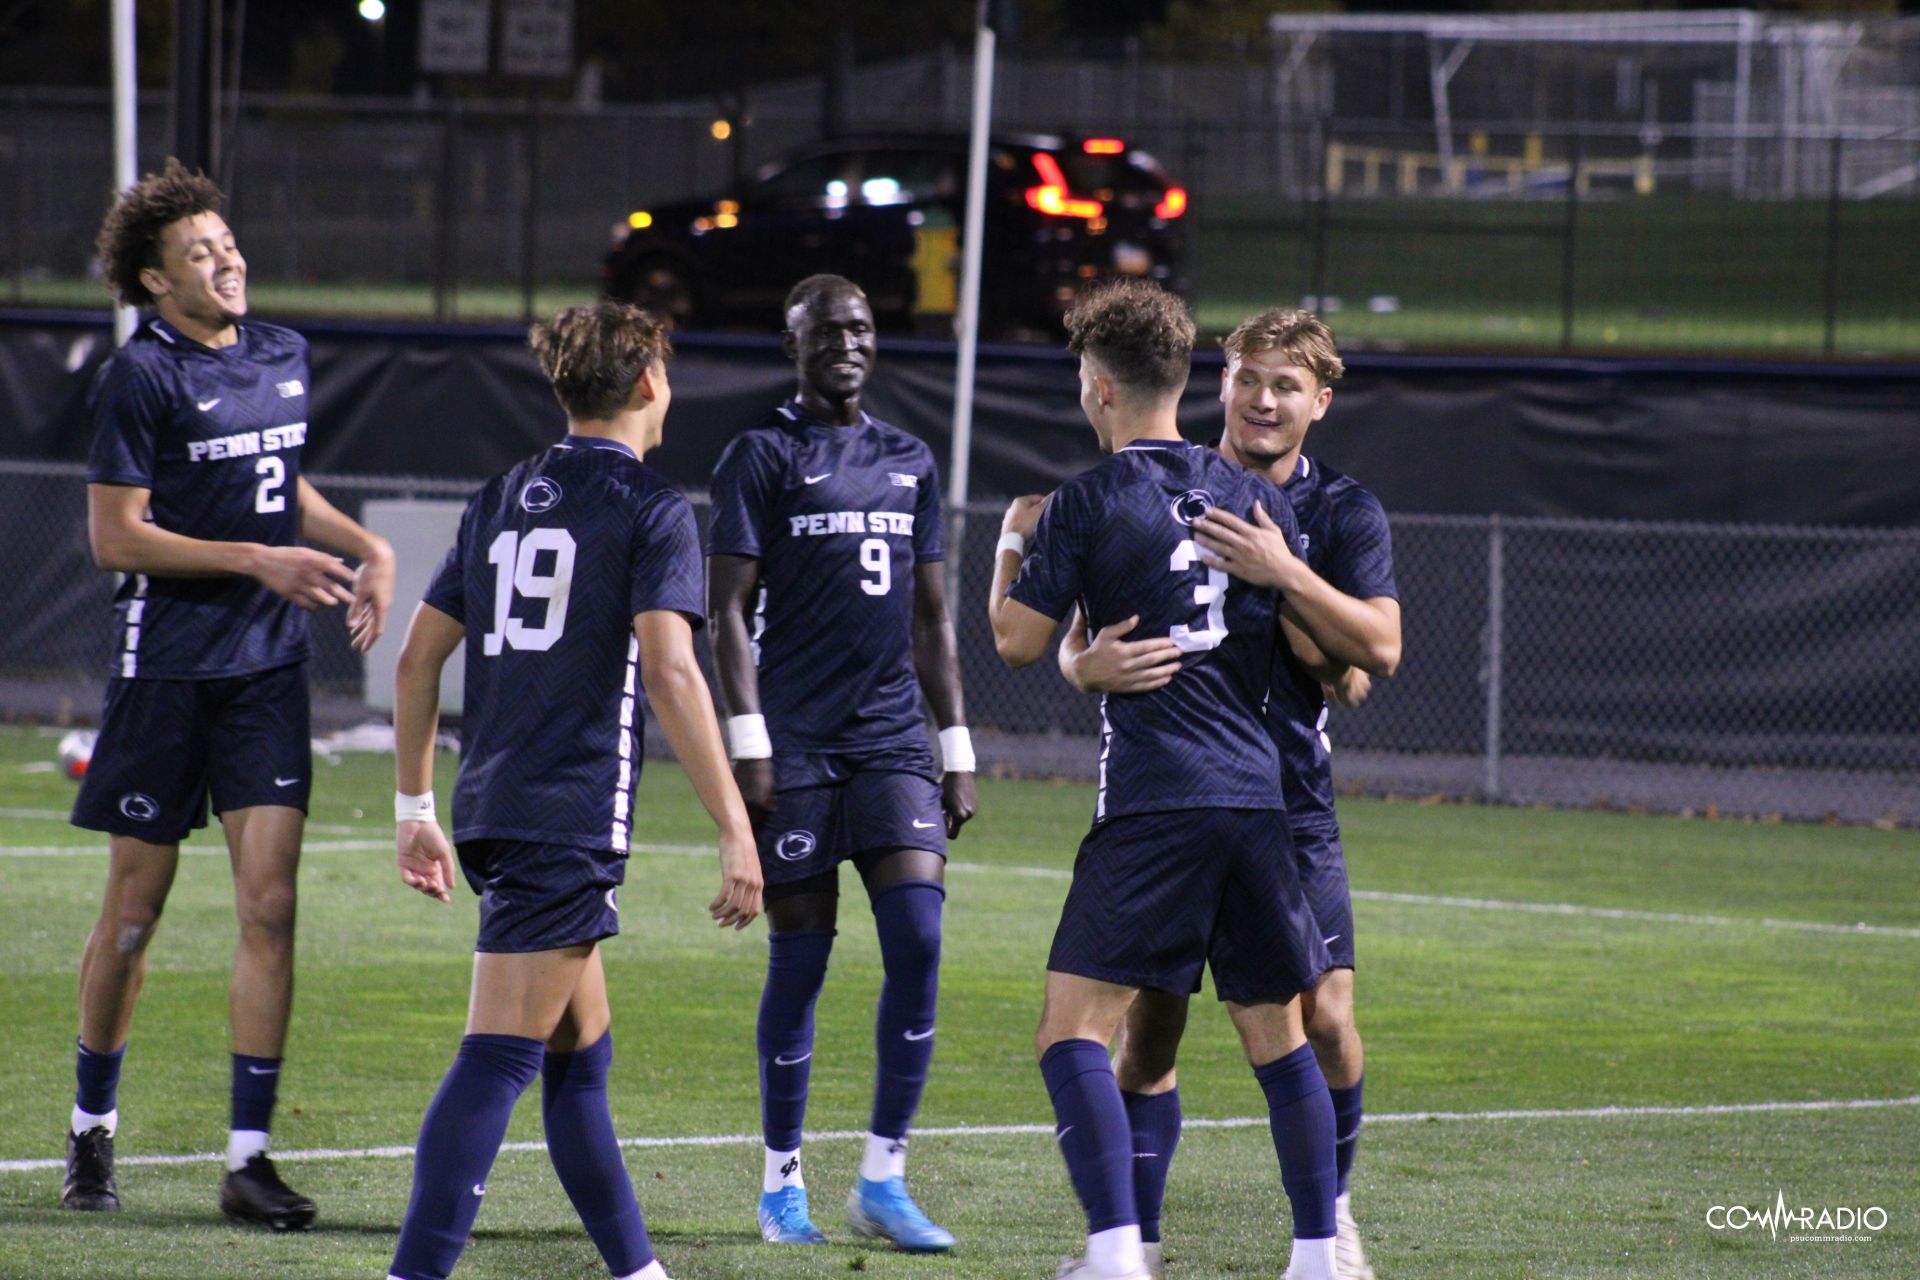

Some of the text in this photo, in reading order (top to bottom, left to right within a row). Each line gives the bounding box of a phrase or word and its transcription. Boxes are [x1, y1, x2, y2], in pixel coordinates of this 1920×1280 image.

[187, 432, 261, 462] PENN
[255, 456, 285, 513] 2
[789, 511, 866, 536] PENN
[483, 528, 577, 656] 19
[860, 538, 891, 596] 9
[1169, 540, 1230, 653] 3
